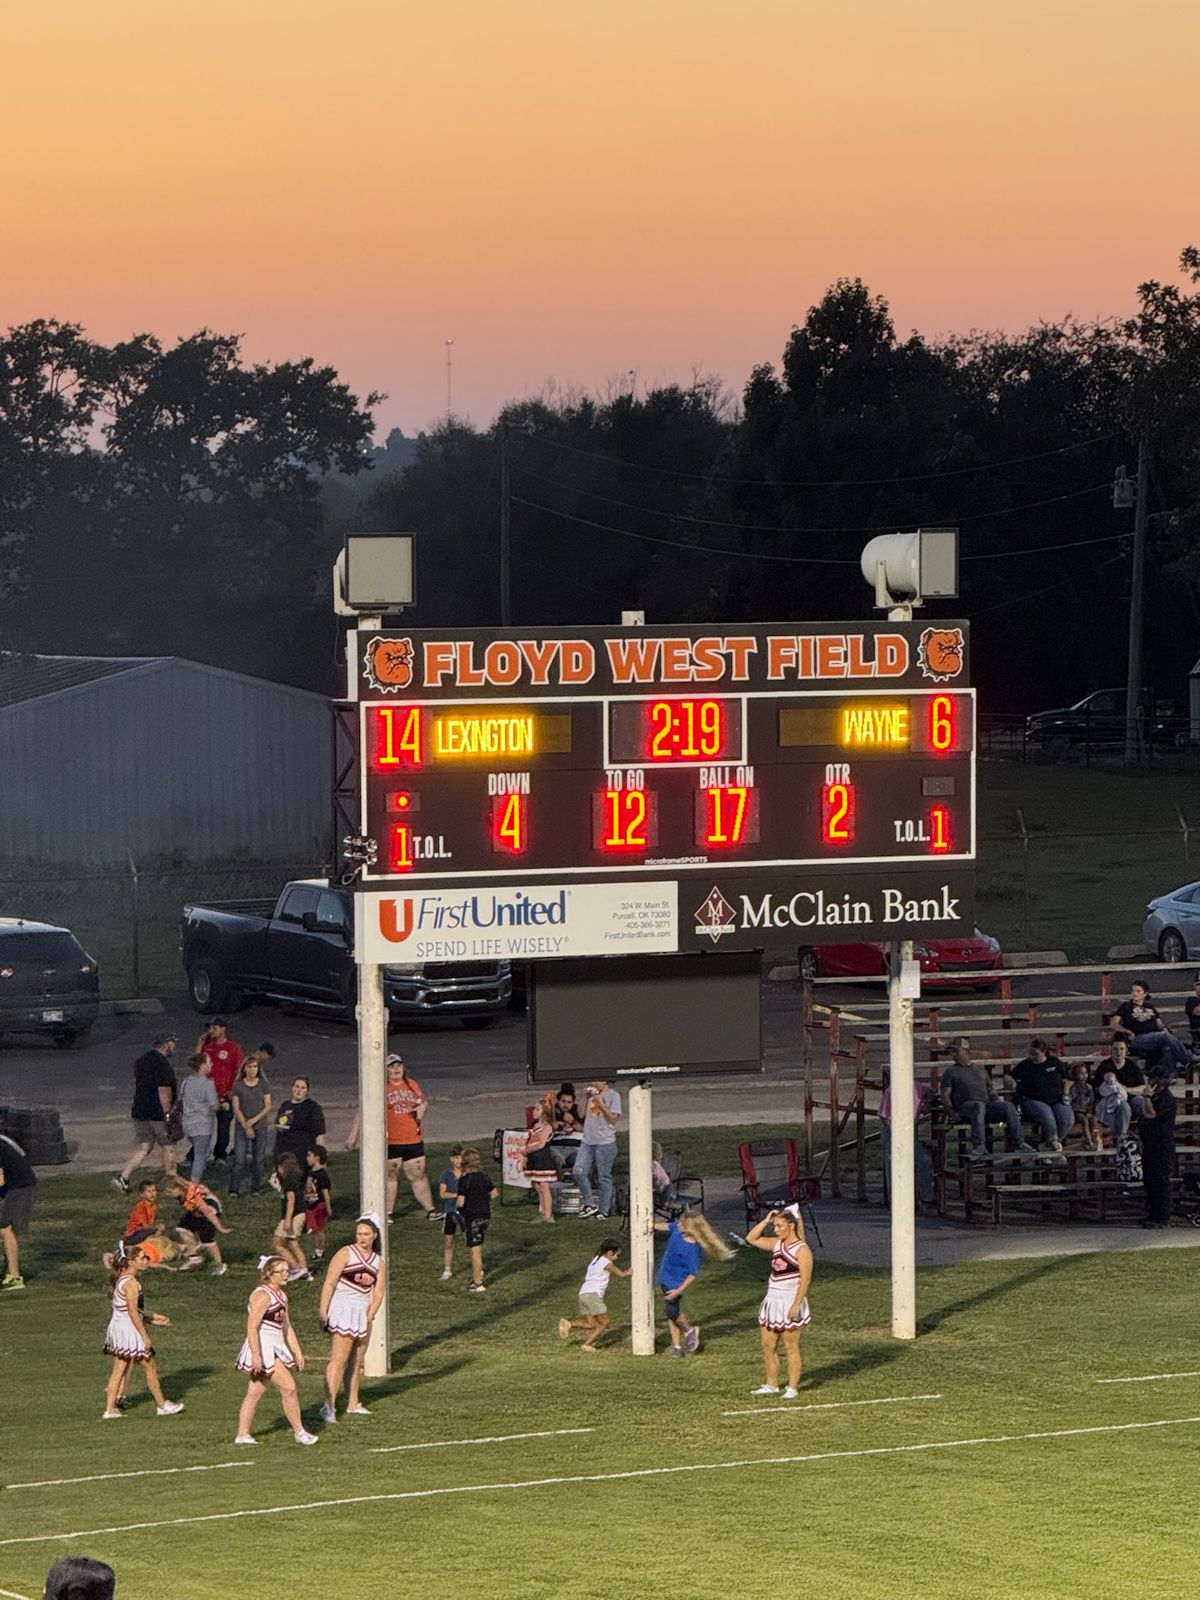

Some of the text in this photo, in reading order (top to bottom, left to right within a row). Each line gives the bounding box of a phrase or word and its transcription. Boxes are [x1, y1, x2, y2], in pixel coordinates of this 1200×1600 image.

[422, 633, 910, 687] FLOYD WEST FIELD
[379, 708, 422, 764] 14
[437, 718, 533, 753] LEXINGTON
[652, 702, 721, 756] 2:19
[844, 710, 909, 742] WAYNE
[932, 697, 951, 749] 6
[488, 773, 531, 795] DOWN
[606, 769, 645, 792] TO GO
[700, 766, 754, 789] BALL ON
[500, 794, 520, 849] 4
[606, 791, 646, 846] 12
[708, 788, 747, 842] 17
[828, 784, 849, 838] 2
[933, 810, 948, 848] 1
[397, 827, 413, 866] 1
[413, 835, 453, 859] T.O.L.
[894, 820, 931, 842] T.O.L.
[620, 902, 634, 910] 324
[644, 901, 660, 909] Main
[638, 911, 649, 919] OK
[739, 885, 961, 929] McClain Bank
[416, 936, 564, 958] SPEND LIFE WISELY
